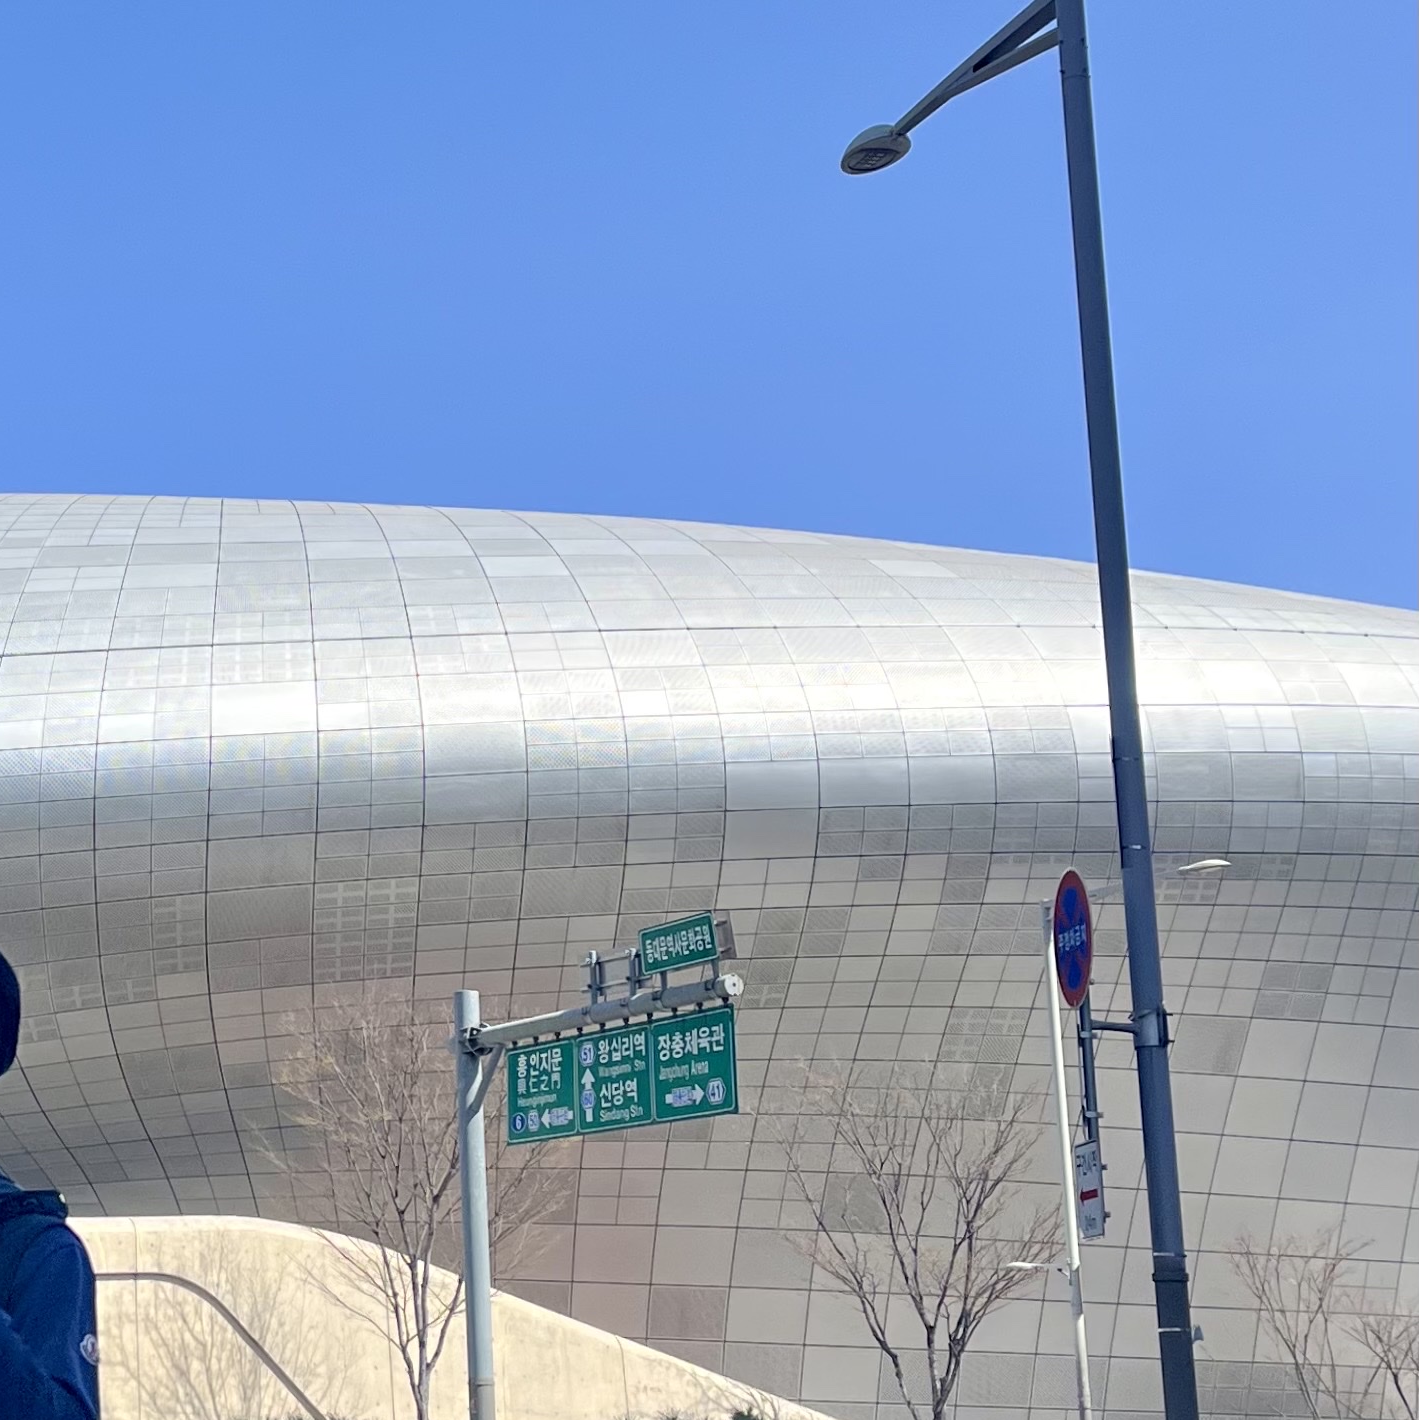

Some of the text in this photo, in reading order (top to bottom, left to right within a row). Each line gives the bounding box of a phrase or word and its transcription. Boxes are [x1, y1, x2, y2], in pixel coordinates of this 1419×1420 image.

[645, 924, 712, 963] 동대문역사문화공원
[597, 1031, 646, 1063] 왕십리역
[657, 1023, 725, 1061] 장충체육관
[517, 1048, 562, 1077] 흥인지문
[691, 1060, 709, 1074] Arena
[599, 1077, 638, 1108] 신당역
[710, 1083, 721, 1099] 41
[600, 1108, 629, 1122] Sindang
